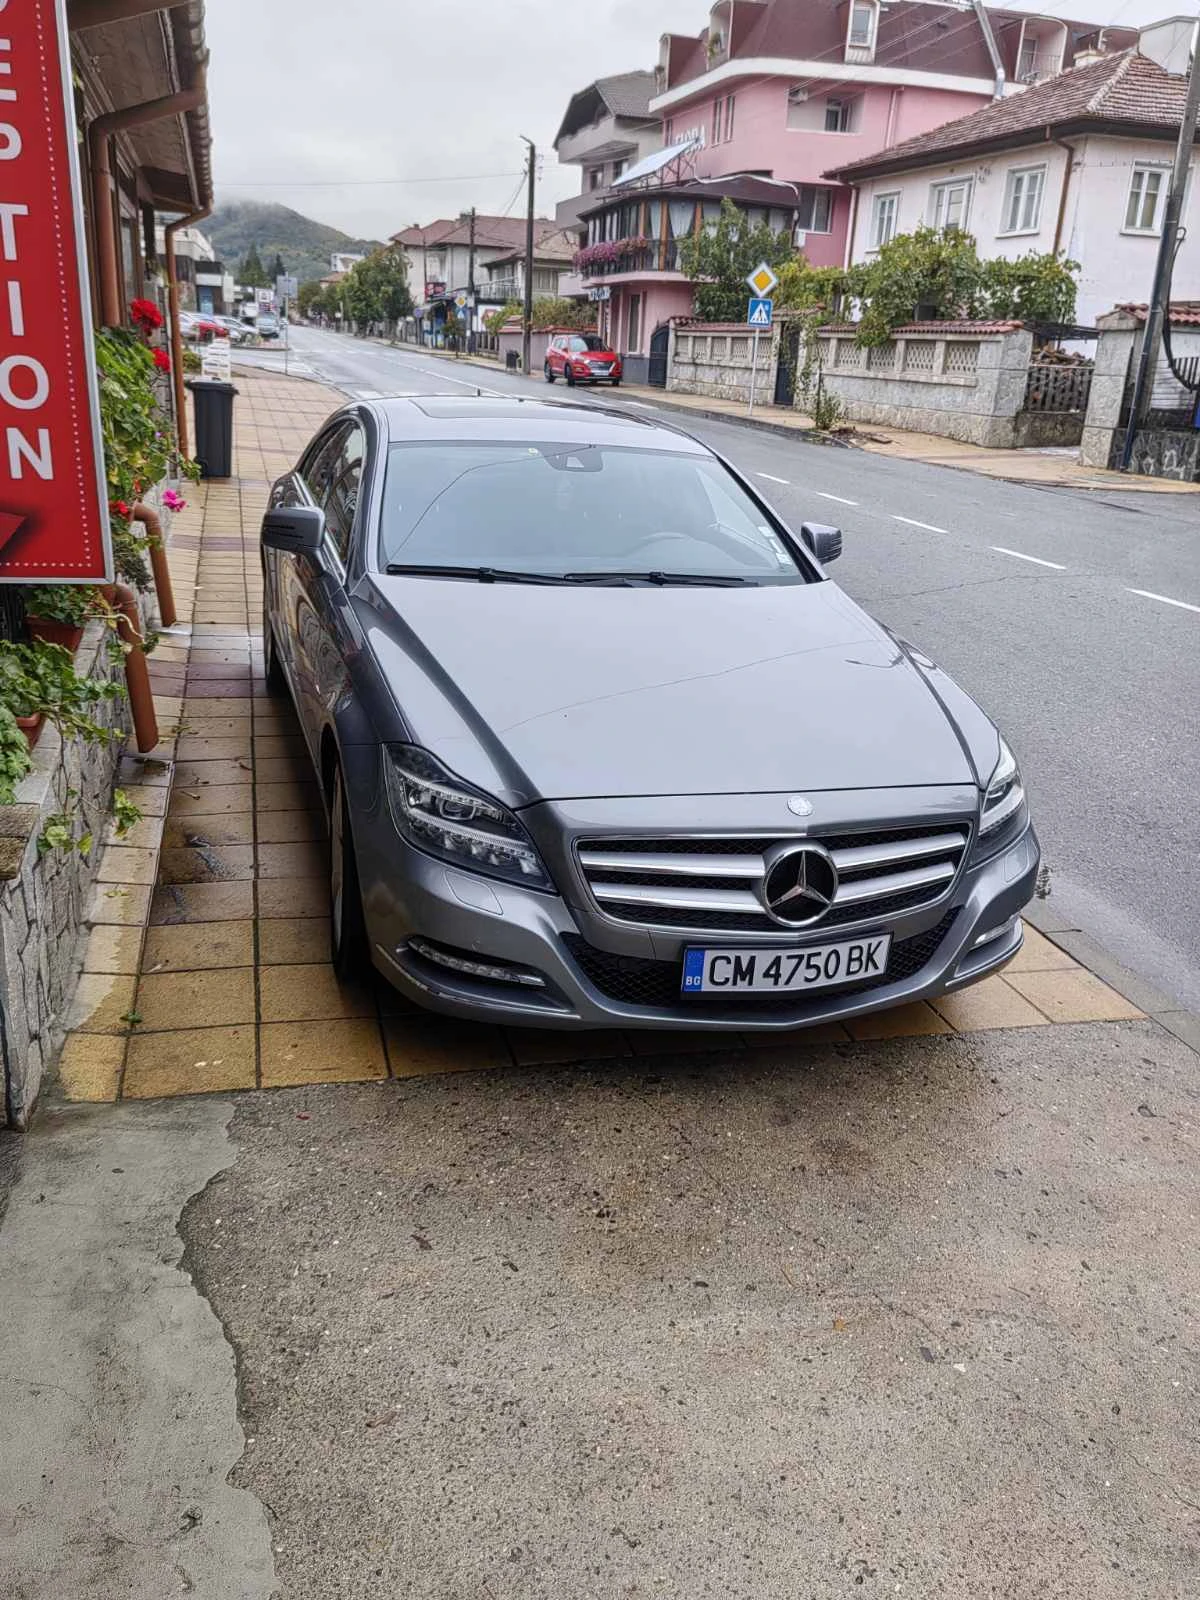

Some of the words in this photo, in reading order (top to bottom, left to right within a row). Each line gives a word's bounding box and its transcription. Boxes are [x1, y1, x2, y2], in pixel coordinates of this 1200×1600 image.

[0, 0, 54, 480] PTION
[685, 975, 701, 986] BG
[708, 954, 757, 986] CM
[762, 948, 841, 986] 4750
[845, 939, 884, 977] BK
